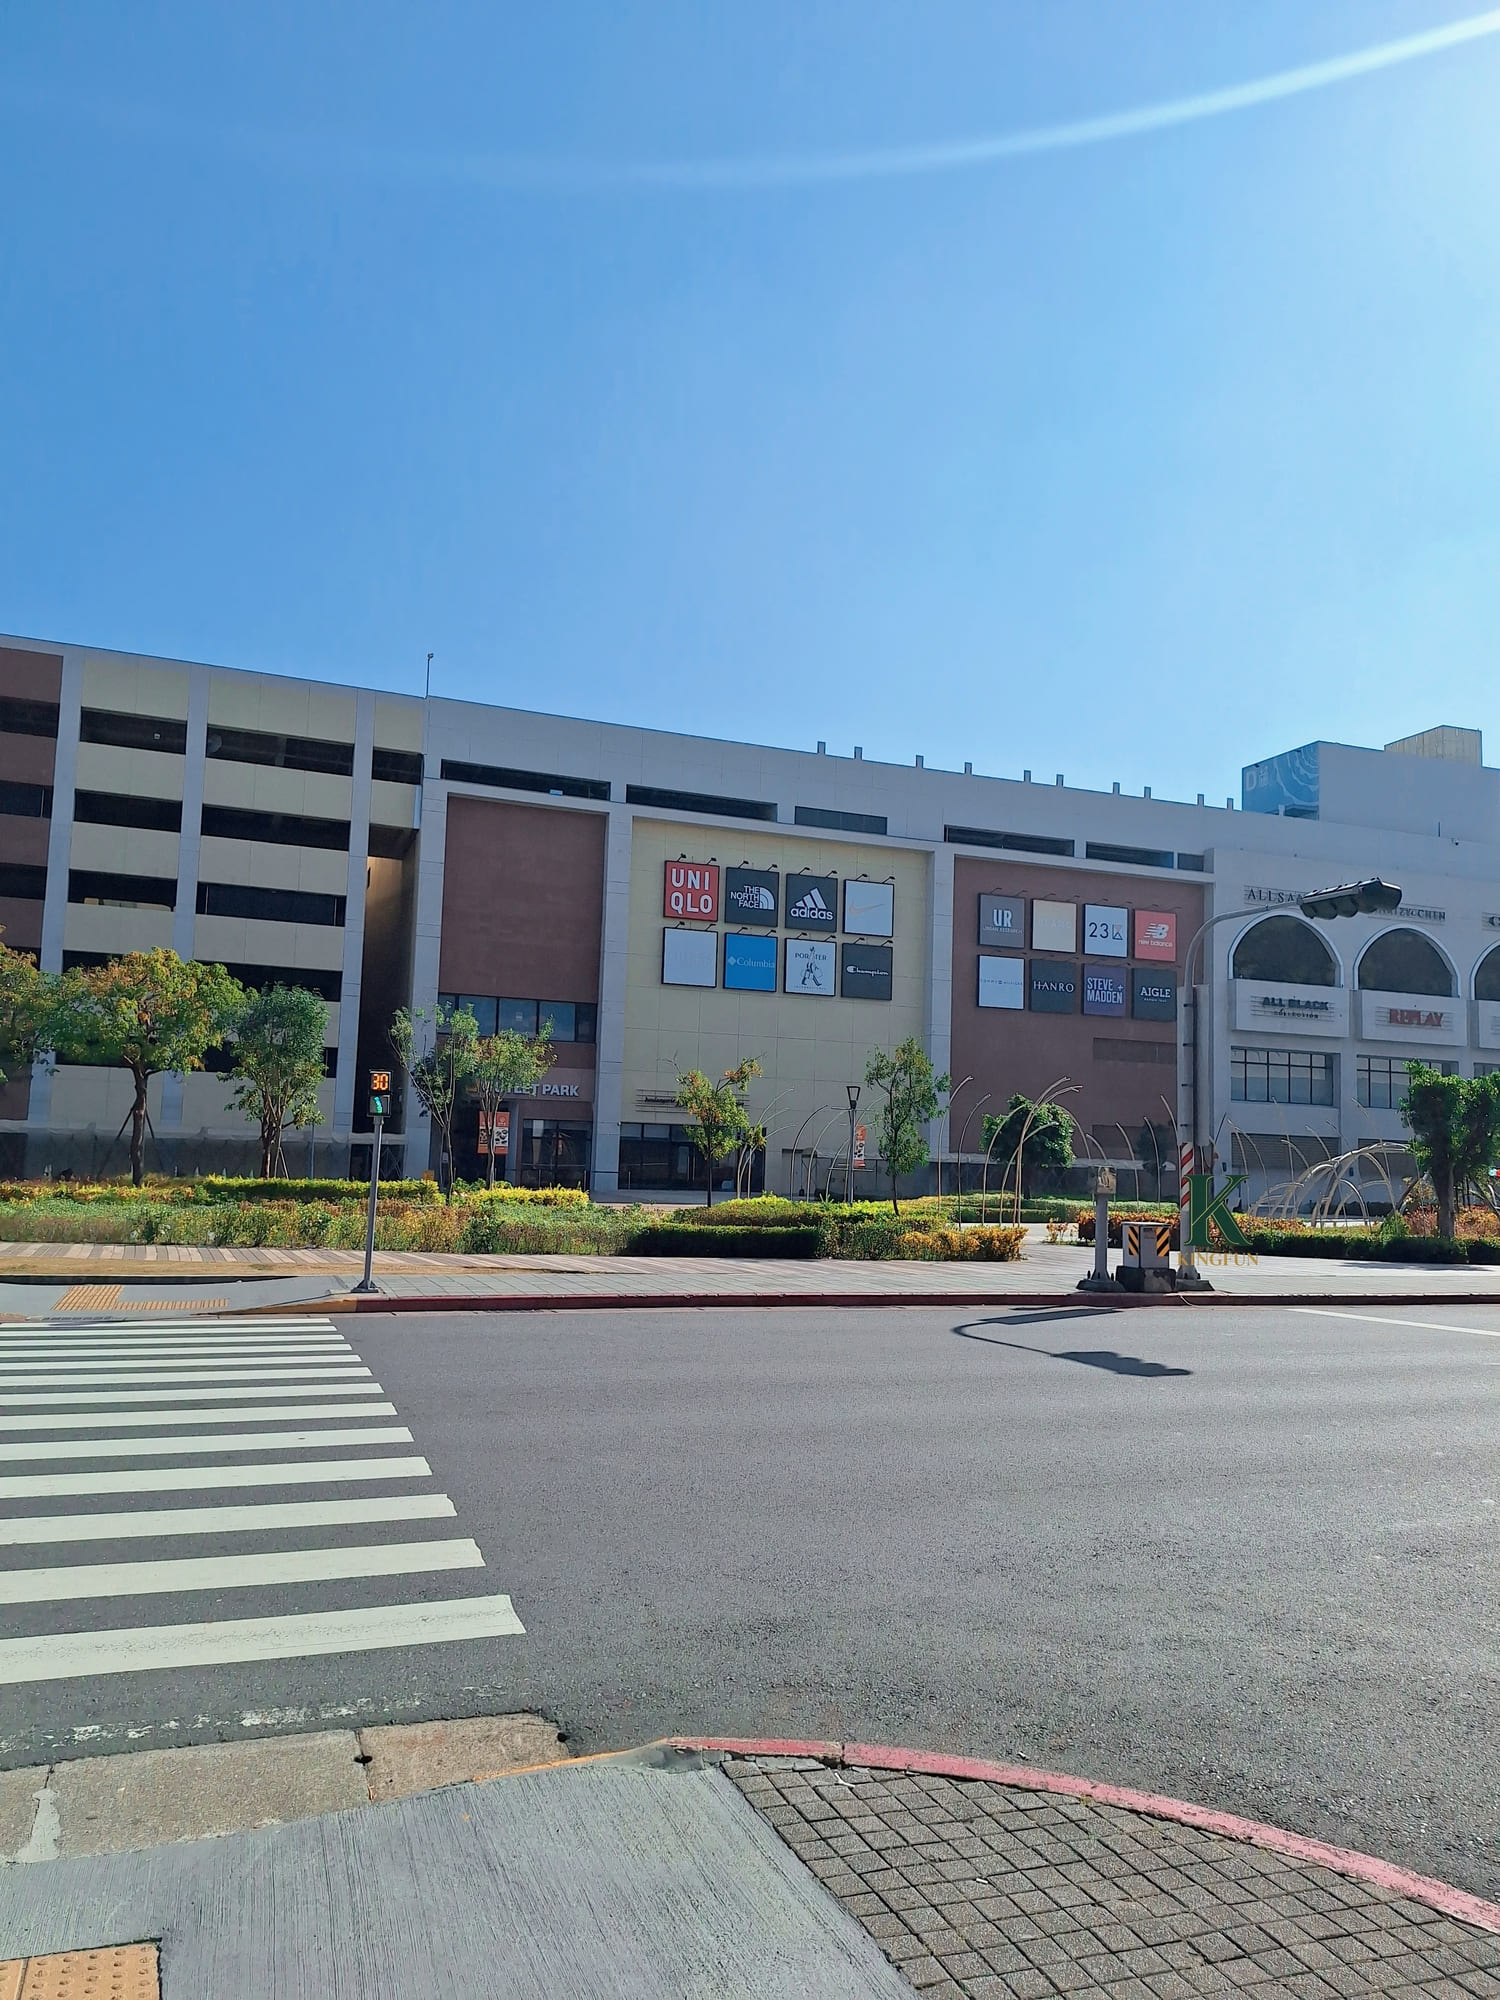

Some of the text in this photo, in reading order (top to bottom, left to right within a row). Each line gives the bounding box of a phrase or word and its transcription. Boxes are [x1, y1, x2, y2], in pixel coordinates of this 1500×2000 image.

[671, 868, 710, 891] UNI
[730, 891, 760, 901] NORTH
[743, 885, 760, 894] THE
[670, 892, 713, 914] QLO
[738, 900, 760, 909] FACE
[790, 906, 834, 920] adidas
[993, 908, 1012, 928] UR
[1150, 940, 1173, 948] balance
[736, 956, 776, 969] Columbia
[846, 965, 889, 977] Champion
[1033, 980, 1074, 993] HANRO
[1087, 977, 1113, 991] STEVE
[1087, 990, 1123, 1004] MADDEN
[1140, 987, 1171, 998] AIGLE
[373, 1074, 389, 1090] 30
[542, 1084, 579, 1096] PARK
